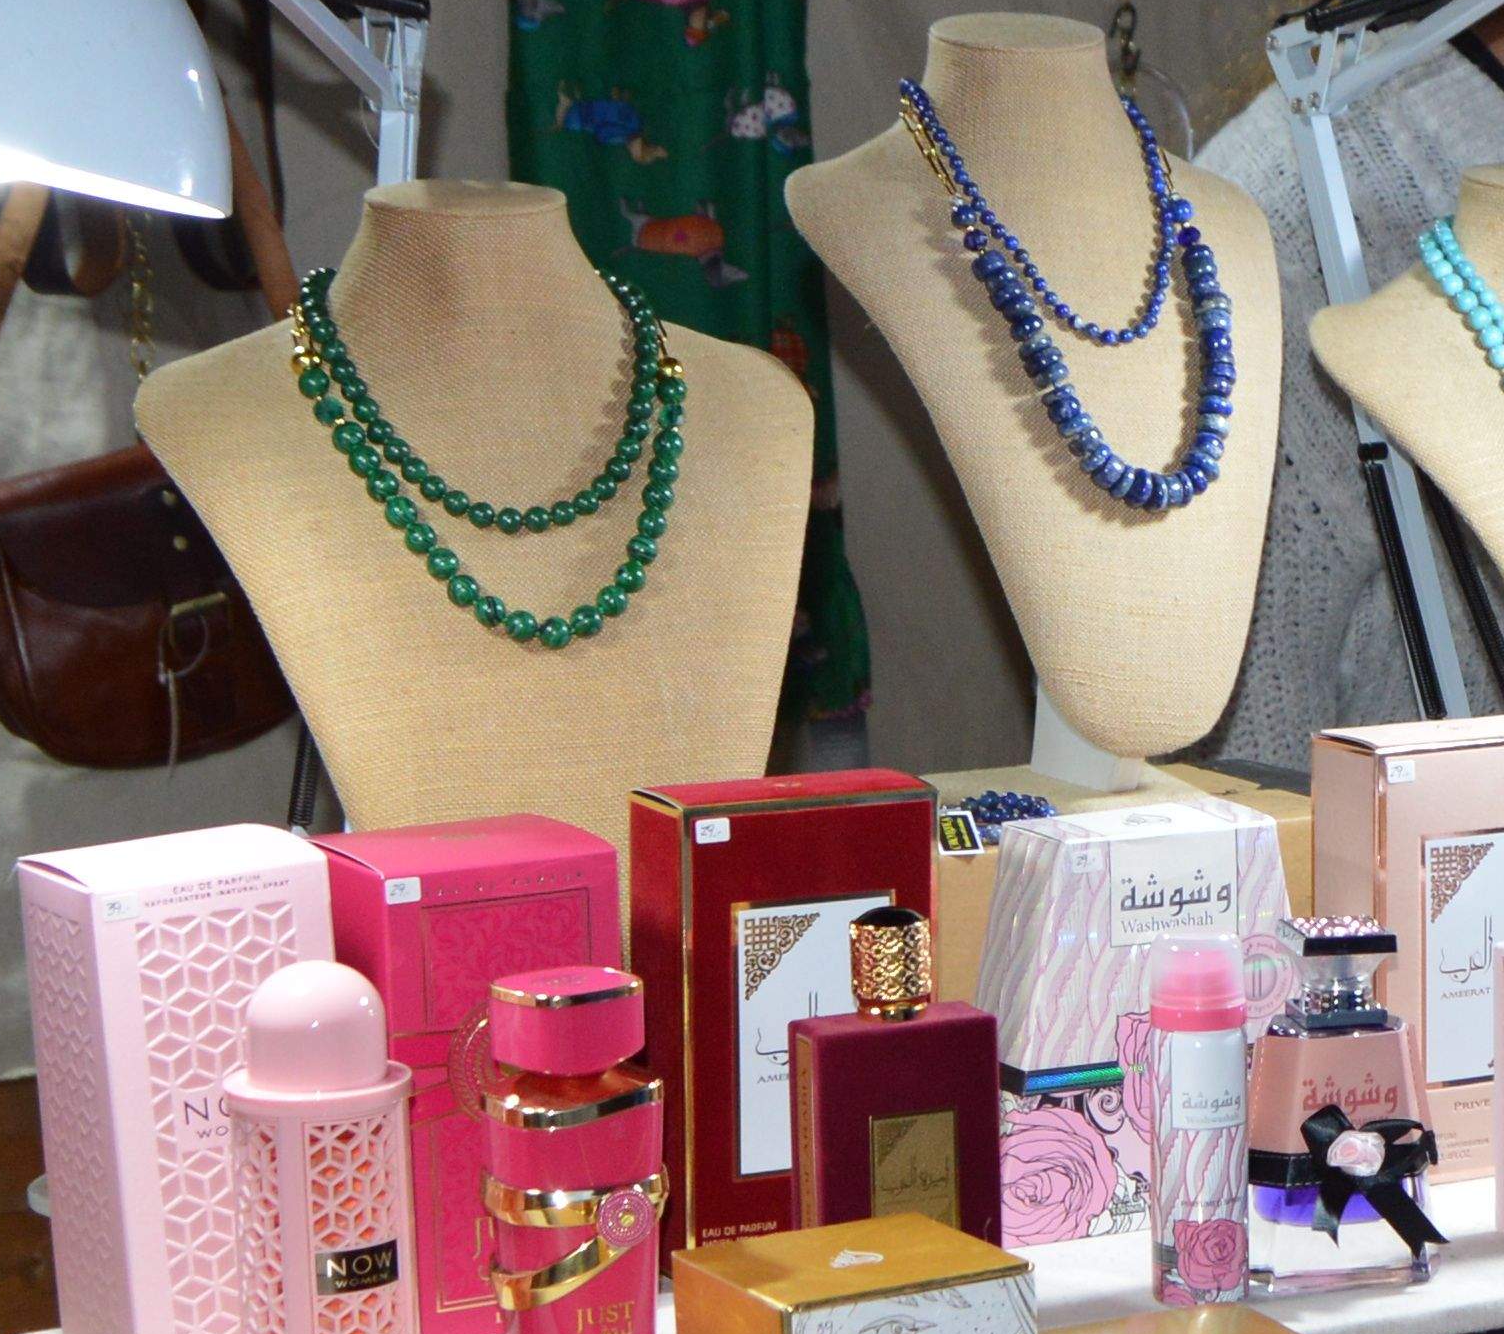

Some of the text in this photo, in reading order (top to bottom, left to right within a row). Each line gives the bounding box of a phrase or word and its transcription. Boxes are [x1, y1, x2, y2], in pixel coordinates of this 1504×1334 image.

[1120, 868, 1231, 917] وشوشة
[1120, 911, 1214, 934] Washwashah
[702, 1227, 722, 1238] EAU
[724, 1225, 736, 1236] DE
[326, 1251, 392, 1278] NOW
[576, 1301, 635, 1334] JUST
